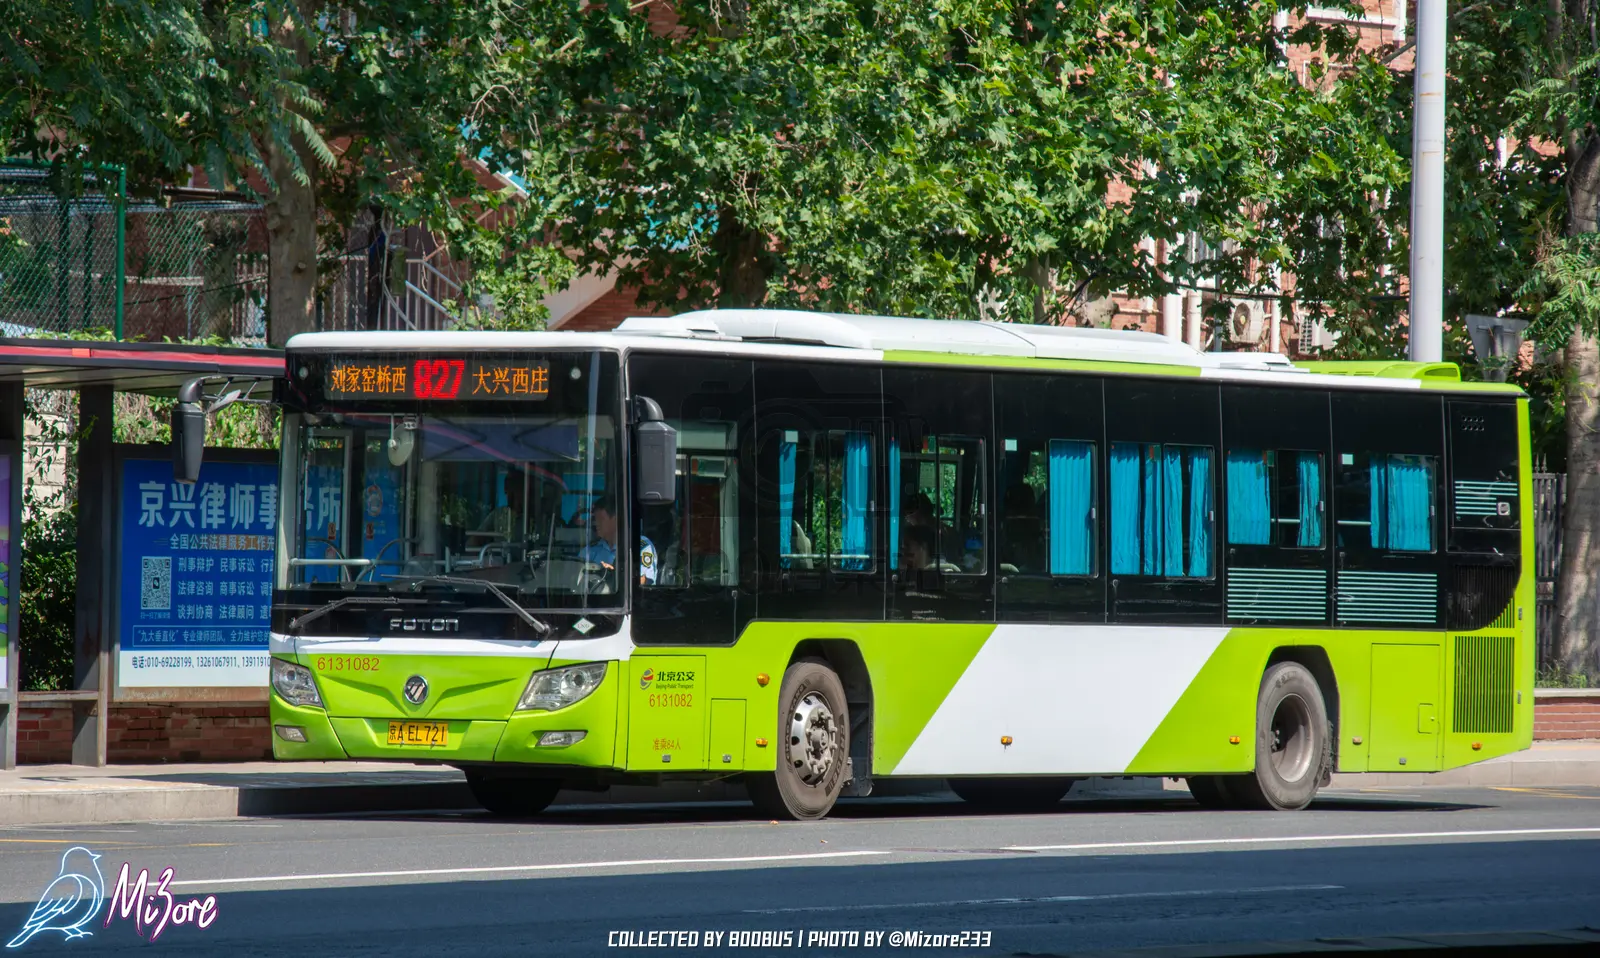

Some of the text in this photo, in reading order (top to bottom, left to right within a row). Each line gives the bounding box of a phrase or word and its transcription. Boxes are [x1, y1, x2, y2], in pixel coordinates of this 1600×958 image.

[330, 359, 548, 399] 刘家窑桥西 827 大兴西庄
[220, 557, 255, 572] 民事诉讼
[178, 581, 214, 596] 法律咨询
[220, 581, 254, 596] 商事诉讼
[177, 604, 213, 620] 谈判协商
[219, 604, 255, 620] 法律顾问
[390, 618, 459, 631] FOTON
[317, 657, 380, 671] 6131082
[657, 671, 695, 682] 北京公交
[649, 693, 693, 708] 6131082
